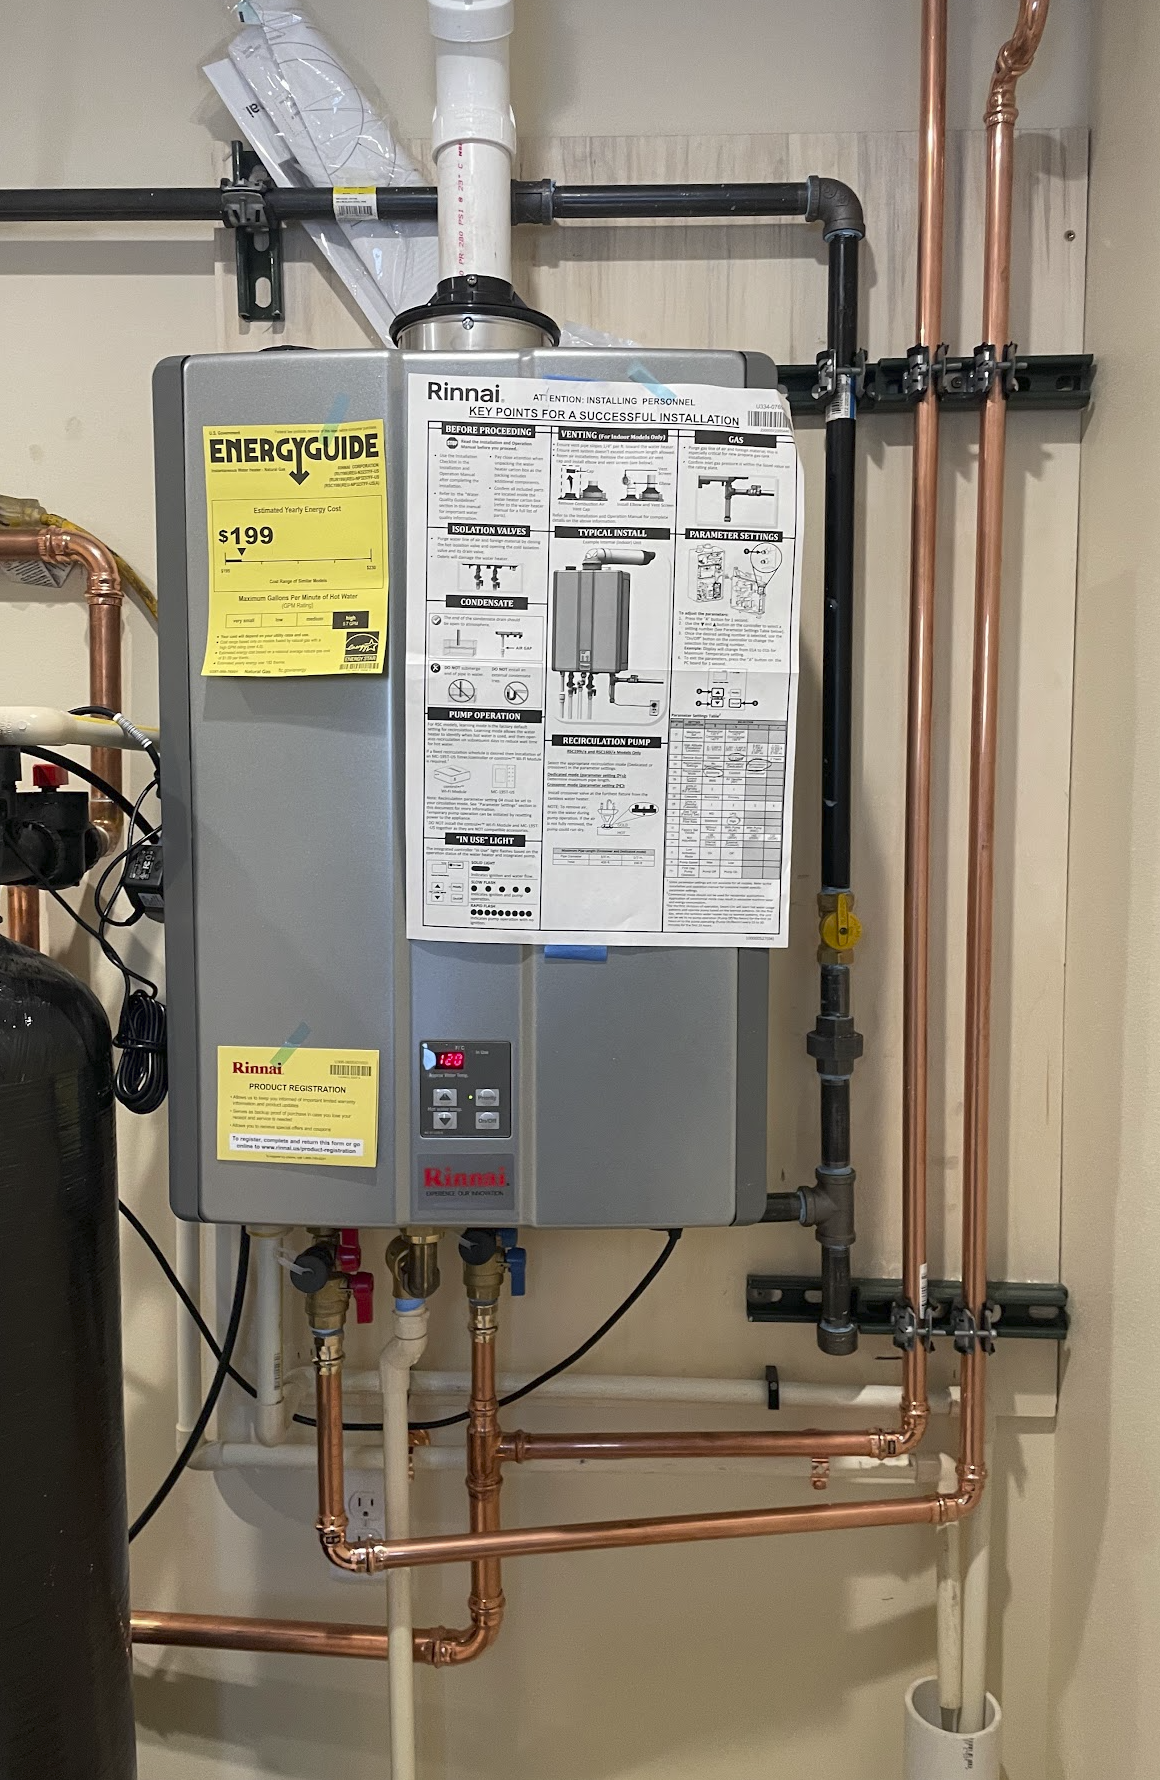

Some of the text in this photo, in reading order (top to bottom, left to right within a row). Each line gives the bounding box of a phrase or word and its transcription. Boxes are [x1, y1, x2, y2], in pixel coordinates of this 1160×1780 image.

[428, 381, 500, 403] Rinnai
[533, 394, 696, 406] ATTENTION: INSTALLING PERSONNEL
[469, 406, 740, 426] KEY POINTS FOR A SUCCESSFUL INSTALLATION
[445, 425, 532, 436] BEFORE PROCEEDING
[561, 431, 598, 439] VENTING
[598, 432, 610, 440] (For
[611, 432, 630, 440] Indoor
[651, 433, 666, 441] Only)
[729, 436, 744, 444] GAS
[209, 433, 379, 463] ENERGYGUIDE
[284, 506, 303, 514] Yearly
[218, 526, 273, 545] $199
[452, 526, 527, 535] ISOLATION VALVES
[578, 528, 647, 537] TYPICAL INSTALL
[690, 531, 779, 541] PARAMETER SETTINGS
[460, 598, 514, 607] CONDENSATE
[449, 711, 521, 720] PUMP OPERATION
[563, 737, 651, 746] RECIRCULATION PUMP
[470, 836, 488, 844] USE"
[440, 1054, 463, 1066] 120
[232, 1062, 282, 1075] Rinnai
[249, 1083, 346, 1093] PRODUCT REGISTRATION
[424, 1166, 506, 1188] Rinnai
